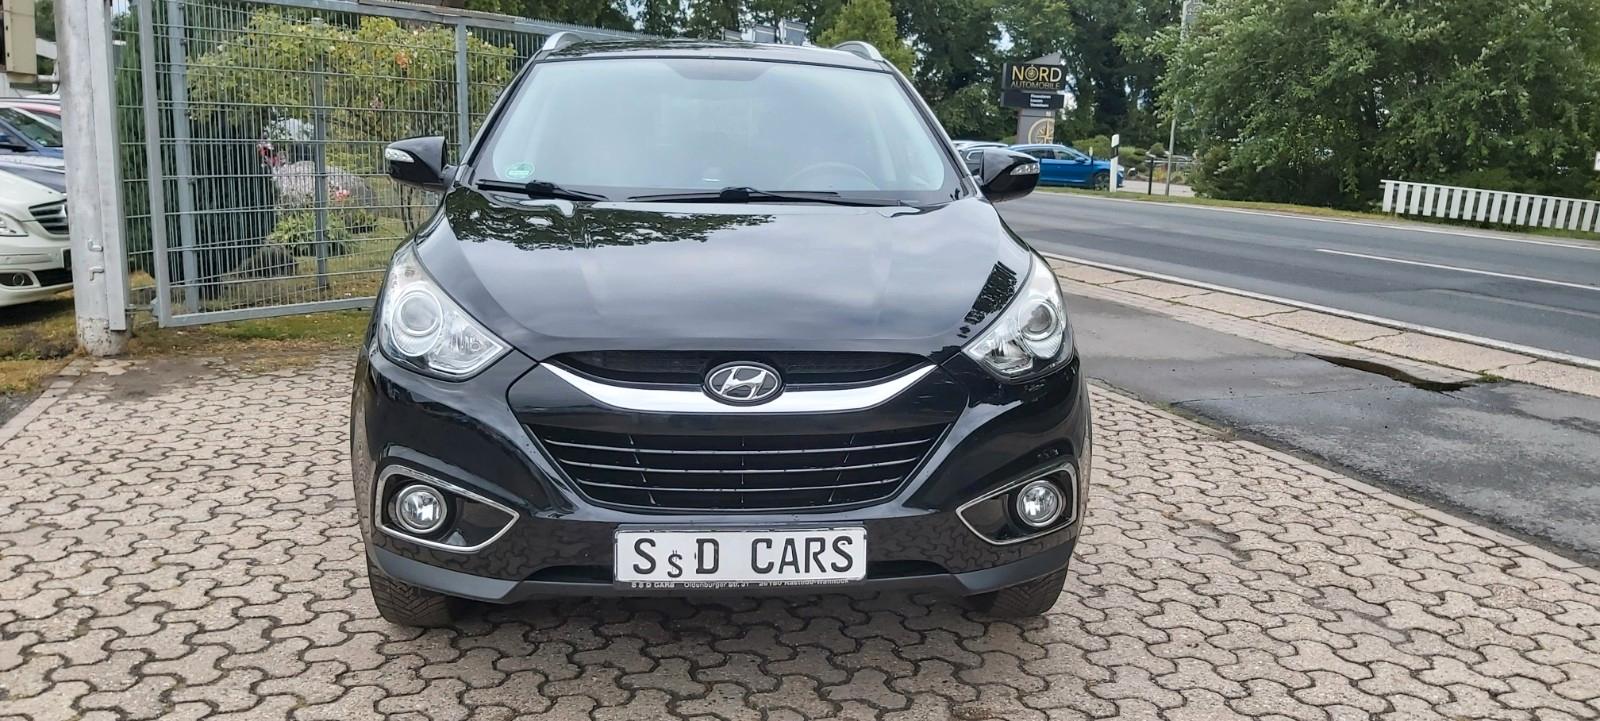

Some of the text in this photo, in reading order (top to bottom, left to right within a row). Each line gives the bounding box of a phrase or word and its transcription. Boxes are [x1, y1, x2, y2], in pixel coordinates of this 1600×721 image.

[1012, 65, 1062, 82] NORD
[1011, 81, 1061, 89] AUTOMOBILE
[751, 535, 854, 574] CARS
